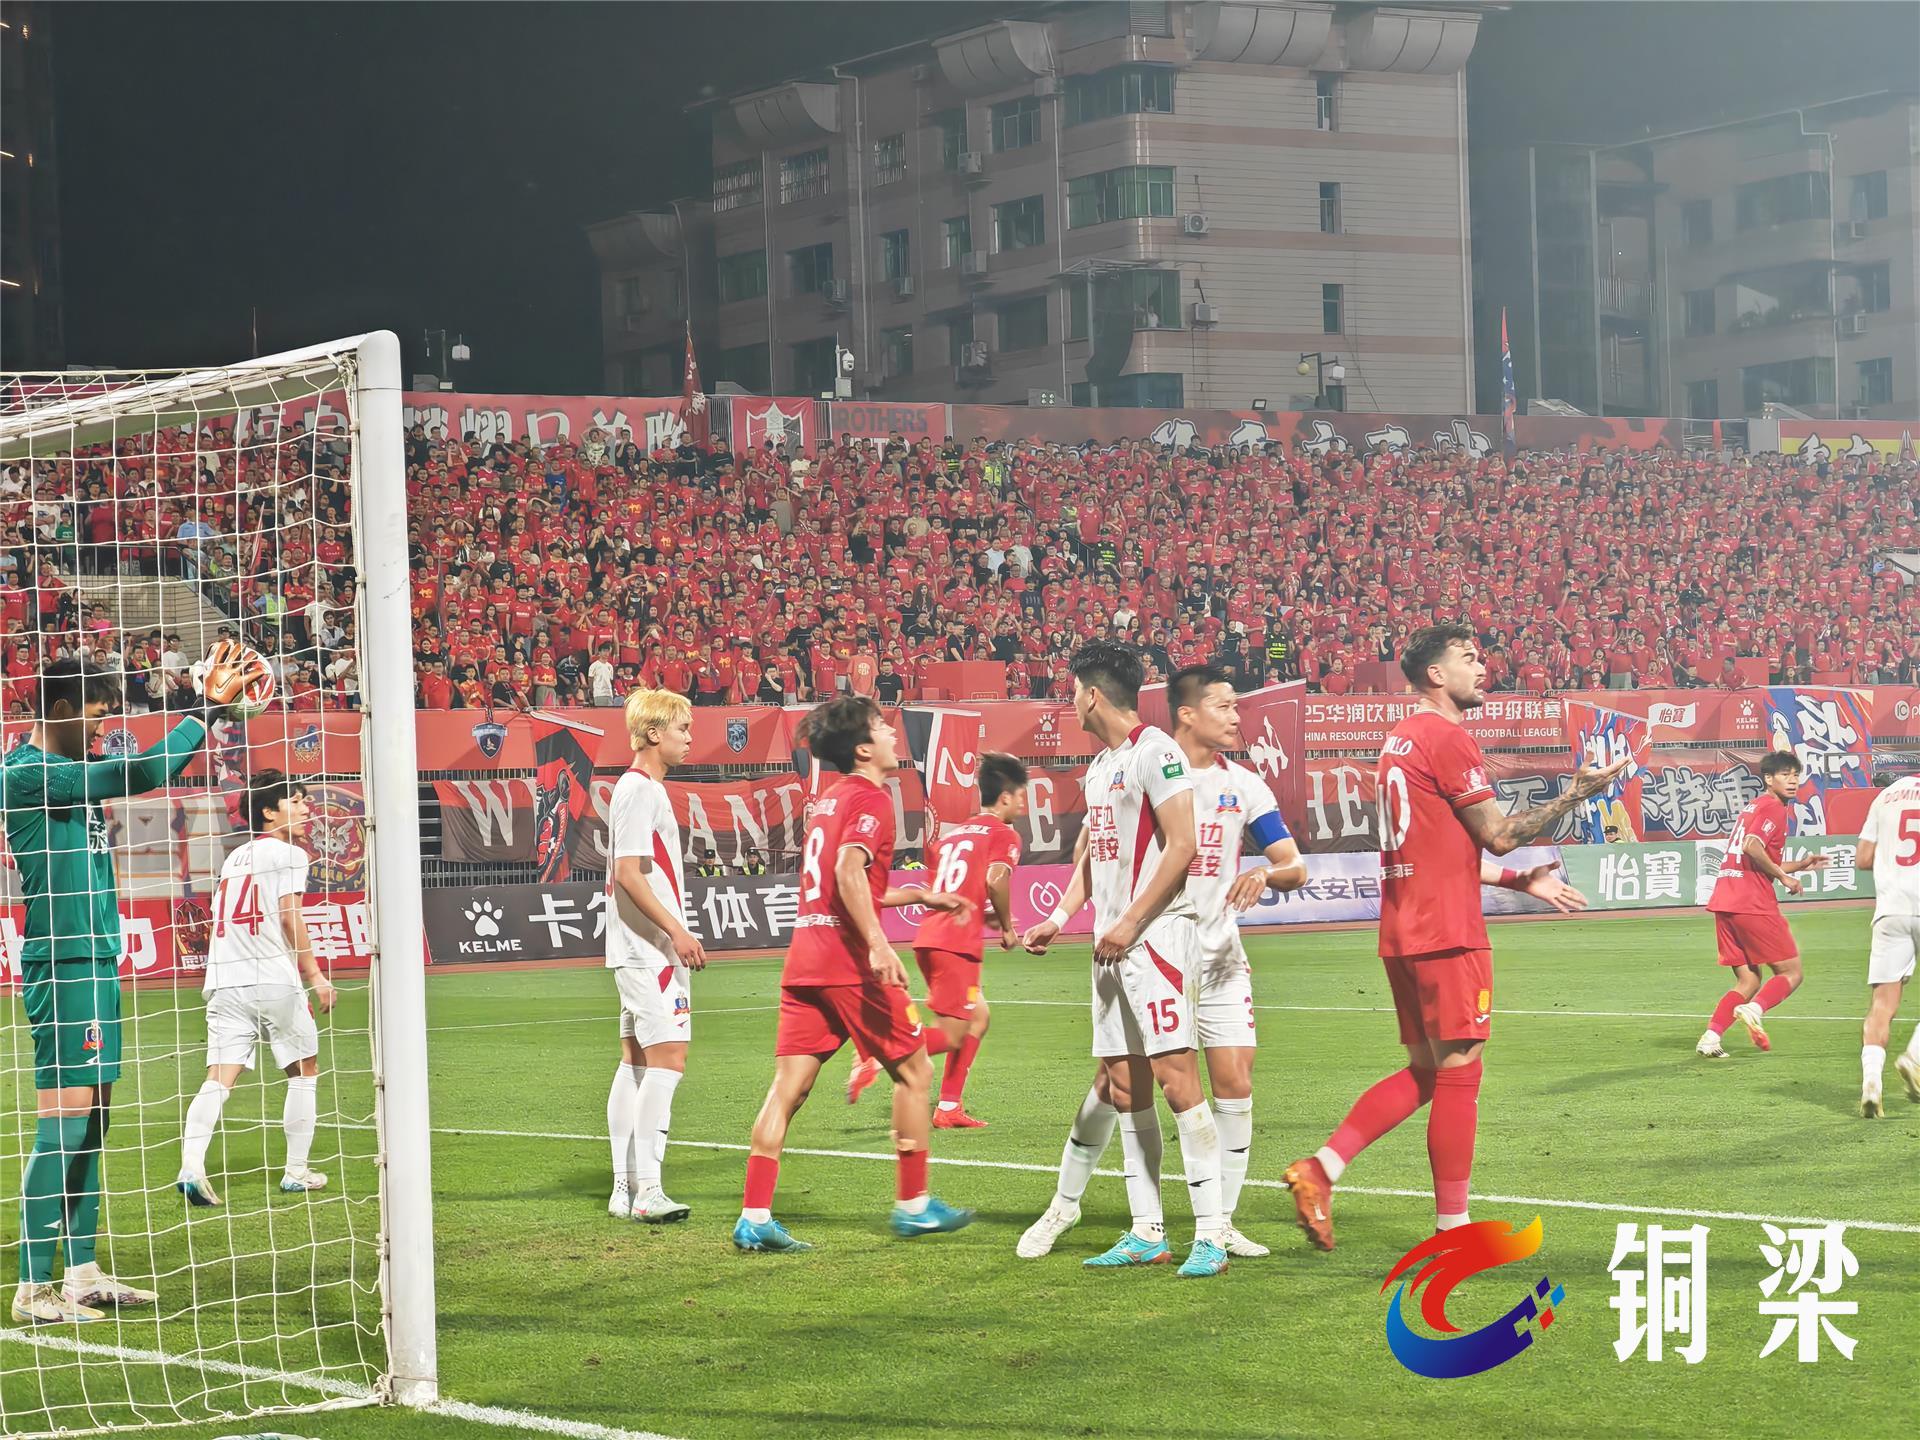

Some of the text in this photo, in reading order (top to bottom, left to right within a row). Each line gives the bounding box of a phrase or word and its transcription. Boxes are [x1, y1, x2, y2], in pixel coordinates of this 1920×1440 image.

[1304, 731, 1328, 742] HINA
[1330, 730, 1384, 741] RESOURCES
[1475, 728, 1522, 738] FOOTBALL
[1200, 821, 1223, 848] 边
[1895, 808, 1920, 867] 5
[932, 839, 974, 896] 16
[1599, 850, 1683, 901] 怡寶
[215, 873, 265, 939] 14
[458, 938, 523, 954] KELME
[1146, 997, 1180, 1036] 15
